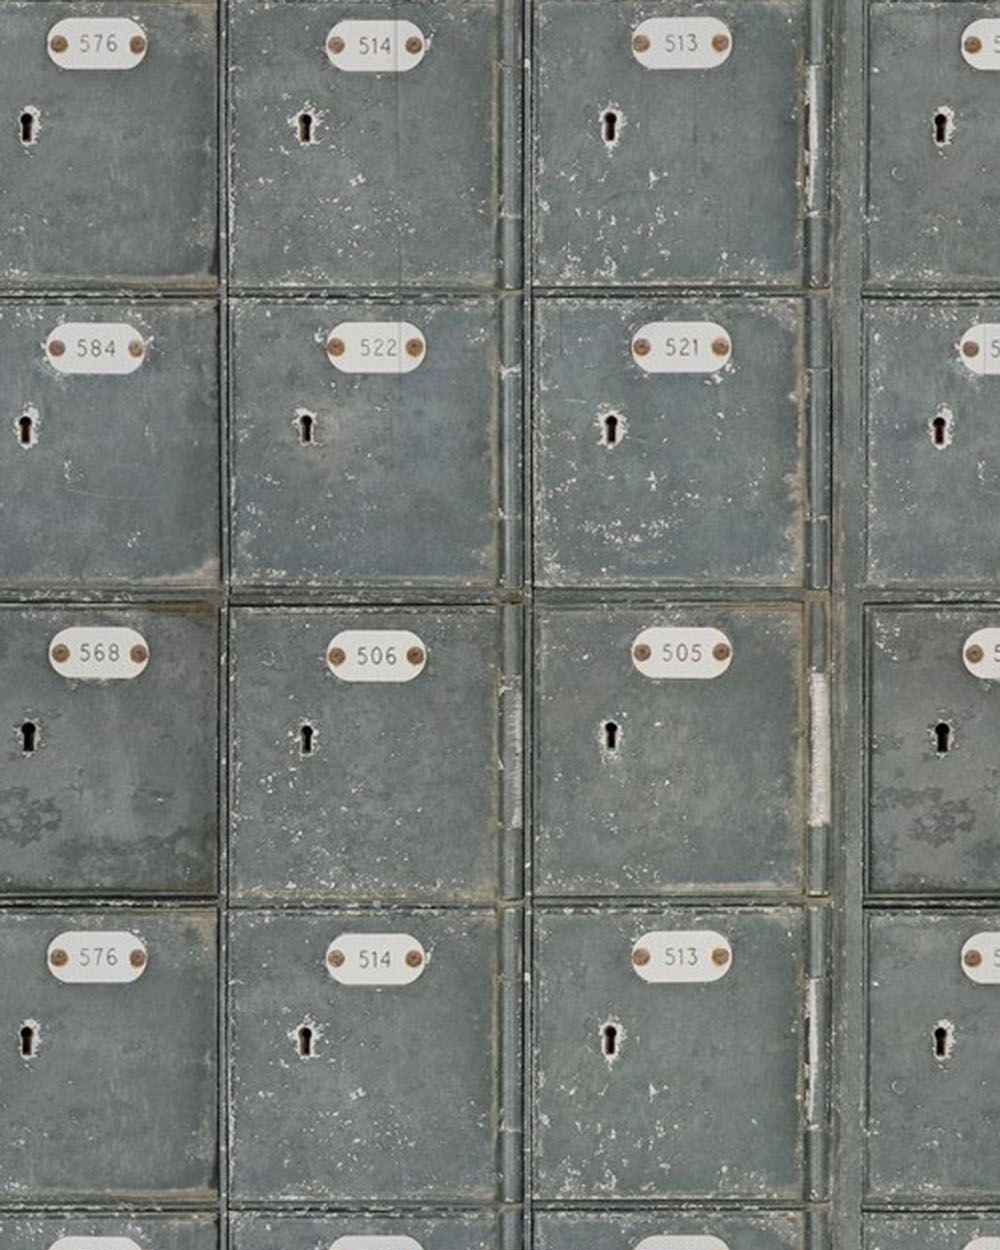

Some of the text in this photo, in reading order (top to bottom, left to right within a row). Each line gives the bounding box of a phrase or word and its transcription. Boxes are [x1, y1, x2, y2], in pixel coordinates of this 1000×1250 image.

[79, 33, 118, 54] 576
[359, 35, 392, 56] 514
[665, 32, 699, 53] 513
[76, 338, 116, 358] 584
[360, 337, 397, 357] 522
[665, 337, 699, 357] 521
[79, 642, 121, 663] 568
[357, 645, 398, 666] 506
[662, 642, 703, 663] 505
[79, 947, 119, 967] 576
[359, 949, 391, 970] 514
[664, 946, 699, 967] 513
